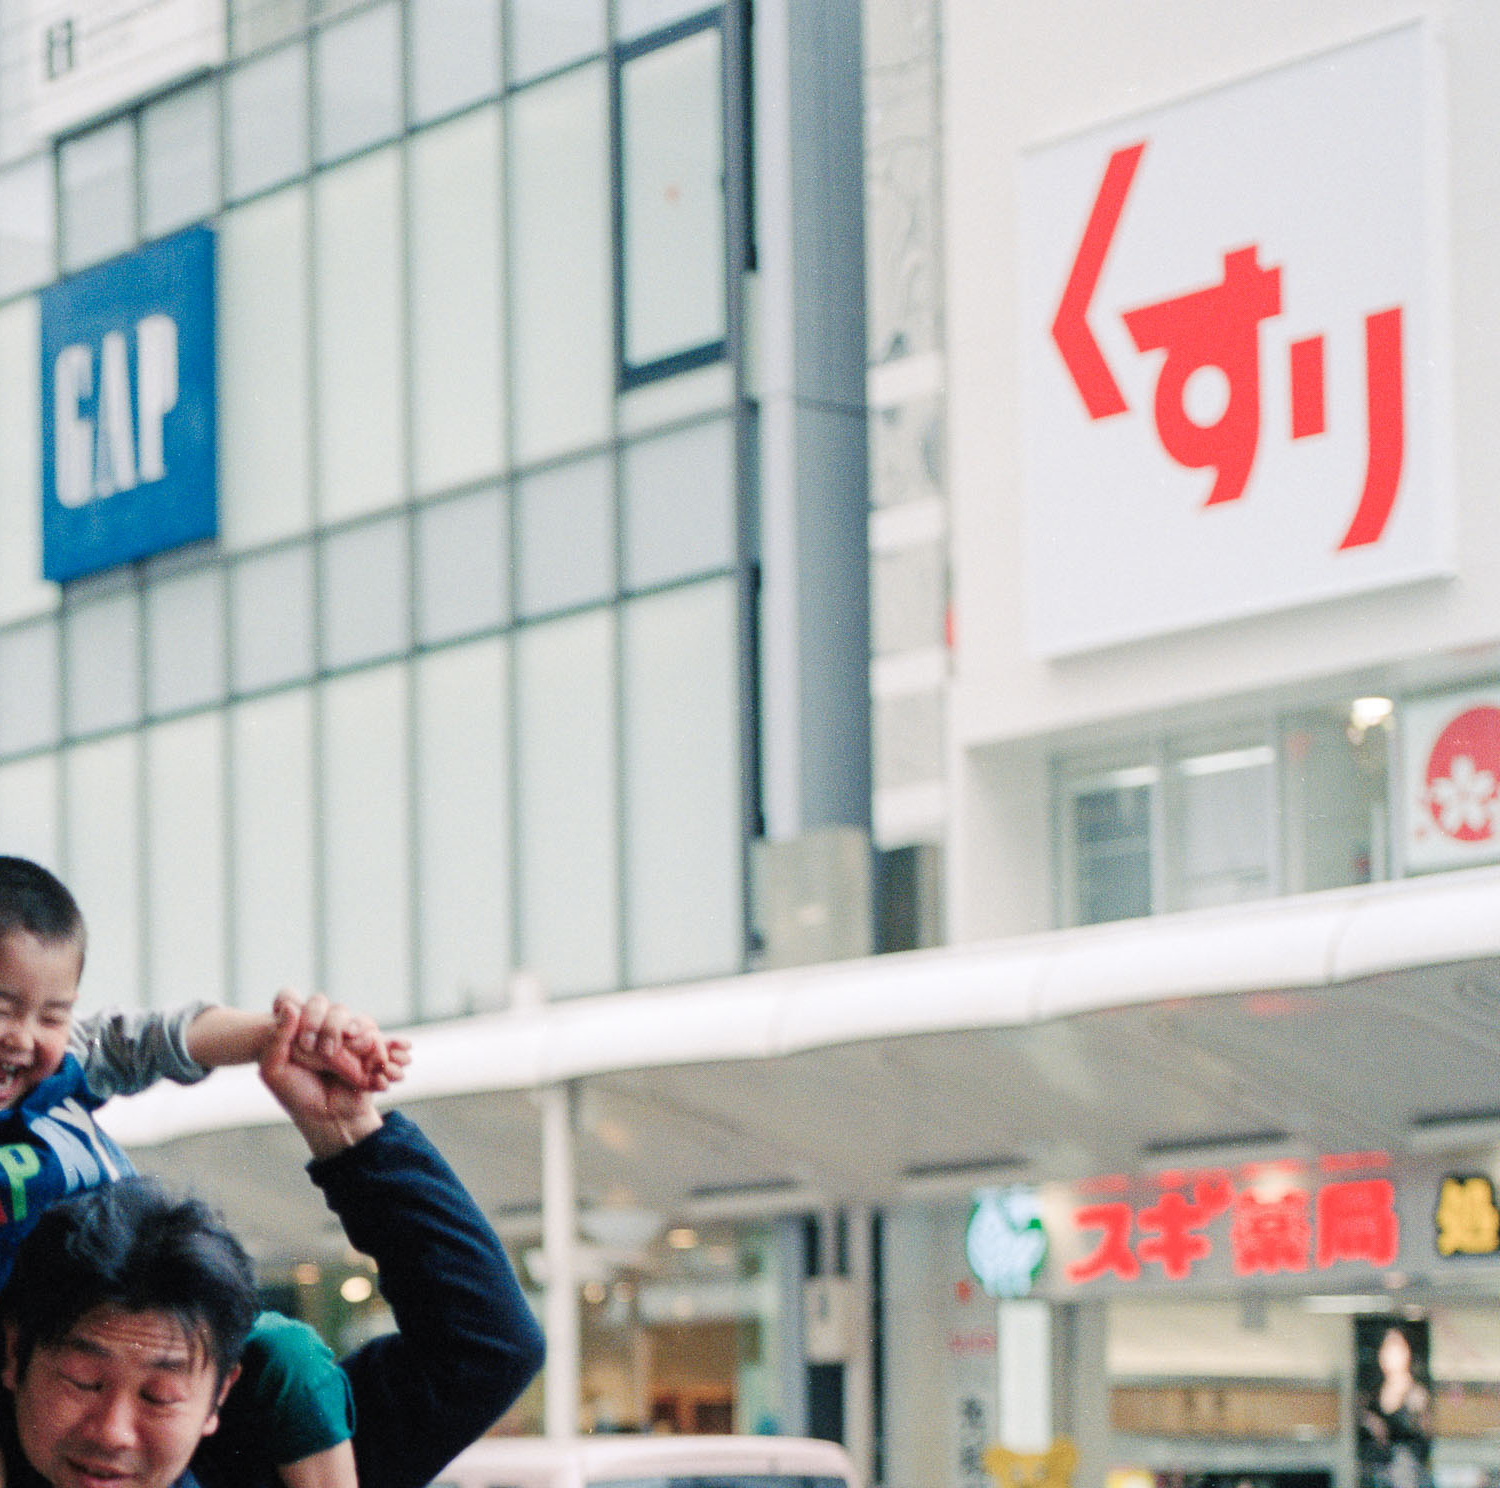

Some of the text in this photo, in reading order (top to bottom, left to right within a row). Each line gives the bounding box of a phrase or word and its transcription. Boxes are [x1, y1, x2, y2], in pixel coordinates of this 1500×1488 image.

[55, 313, 179, 508] GAP
[1051, 139, 1404, 553] くすり
[1065, 1177, 1399, 1284] スギ薬局
